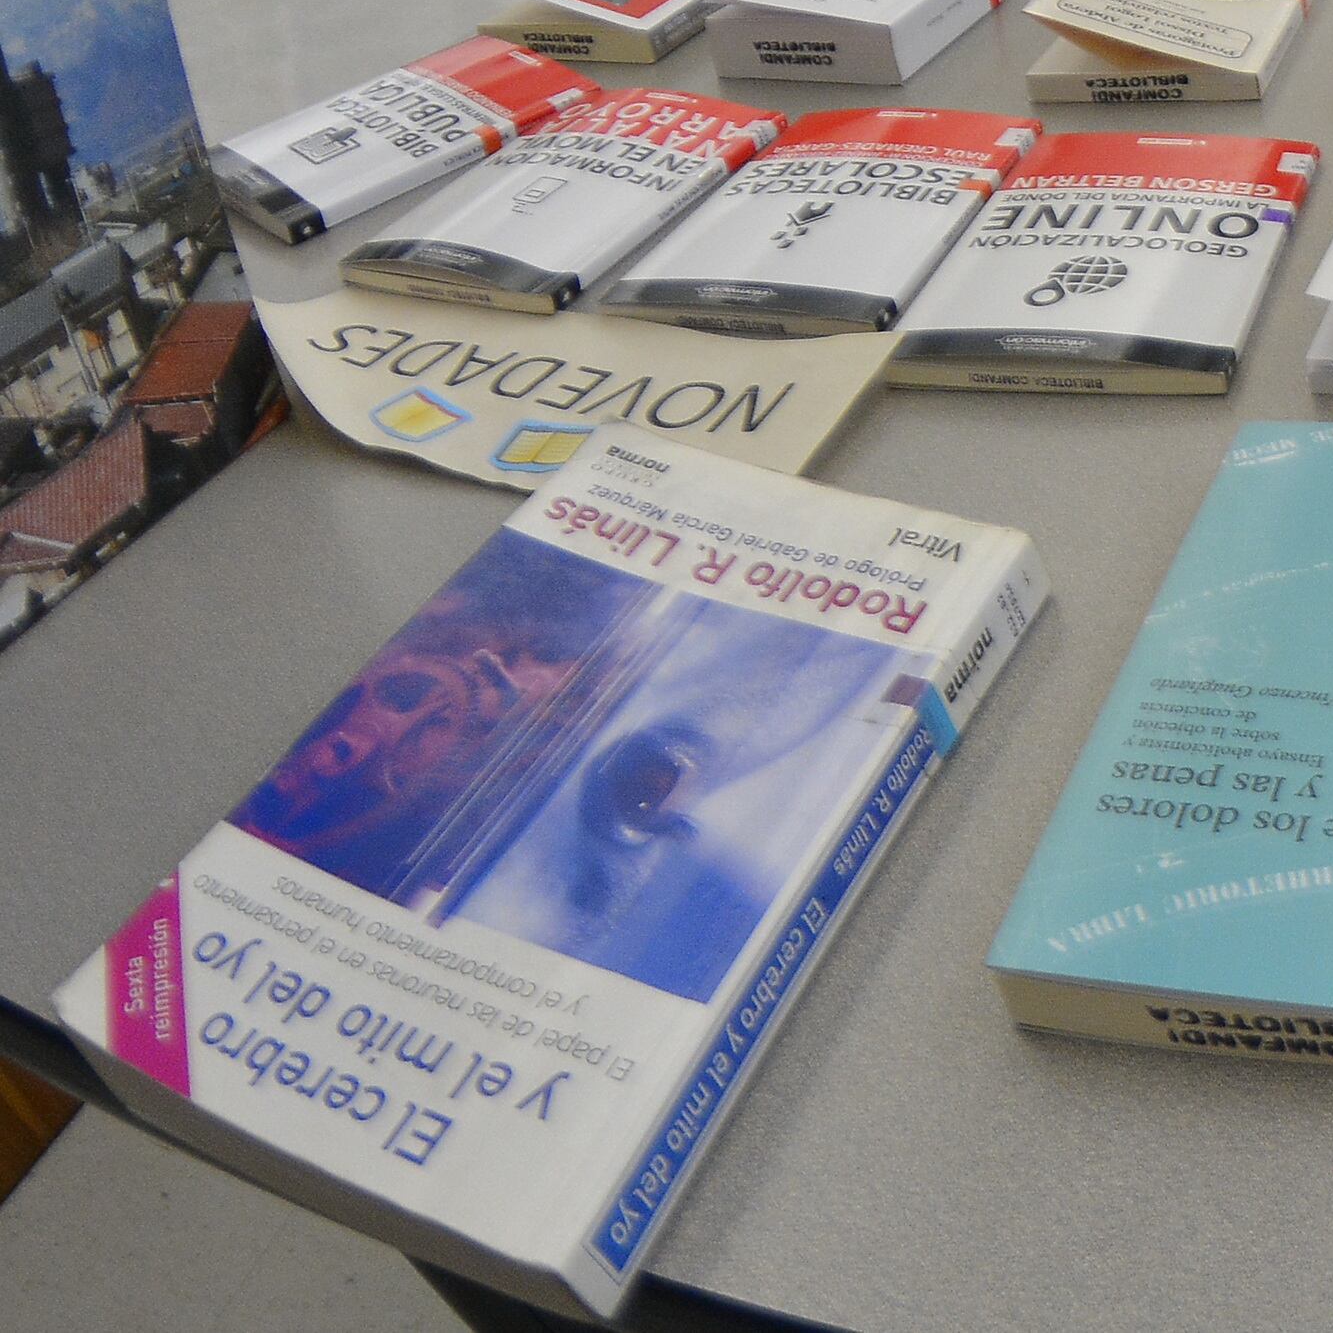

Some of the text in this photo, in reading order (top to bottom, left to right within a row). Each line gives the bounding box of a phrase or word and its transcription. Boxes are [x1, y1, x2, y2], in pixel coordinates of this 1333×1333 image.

[1061, 1, 1119, 25] Abdera
[522, 32, 594, 45] BIBLIOTECA
[752, 40, 837, 54] BIBLIOTECA
[759, 52, 833, 67] COMFANDI
[1085, 73, 1189, 89] BIBLIOTECA
[1091, 88, 1183, 102] COMFANDI
[326, 95, 439, 159] BIBLIOTECA
[358, 79, 469, 144] PÚBLICA
[558, 101, 747, 140] ARROYO
[534, 116, 732, 160] NATALIA
[615, 141, 706, 177] EN EL
[749, 159, 977, 187] ESCOLARES
[724, 177, 959, 207] BIBLIOTECAS
[1071, 190, 1105, 202] DEL
[1108, 190, 1245, 209] IMPORTANCIA
[1245, 198, 1270, 211] LA
[980, 202, 1260, 239] ONLINE
[968, 232, 1248, 260] GEOLOCALIZACIÓN
[305, 322, 797, 435] NOVEDADES
[1034, 376, 1104, 390] BIBLIOTECA
[603, 442, 671, 477] norma
[541, 493, 682, 569] Llinás
[585, 482, 928, 592] Prólogo de Gabriel García Márquez
[886, 524, 964, 564] Vitral
[691, 543, 738, 586] R.
[742, 559, 929, 636] Rodolfo
[943, 625, 994, 705] norma
[1138, 701, 1257, 724] de conciencia
[1120, 733, 1324, 769] Ensayo abolicionista y
[1210, 725, 1227, 739] la
[1230, 727, 1281, 743] sobre
[1110, 759, 1324, 803] y las penas
[1094, 792, 1240, 836] dolores
[1253, 808, 1313, 843] los
[832, 811, 874, 877] Llinás
[269, 875, 588, 1017] y el comportamiento humanos
[1044, 901, 1149, 954] LIBRA
[123, 953, 146, 1014] Sexta
[191, 873, 636, 1083] El papel de las neuronas en el pensamiento
[191, 931, 572, 1122] y el mito del yo
[195, 1011, 454, 1167] El cerebro
[608, 896, 828, 1246] El cerebro y el mito del yo
